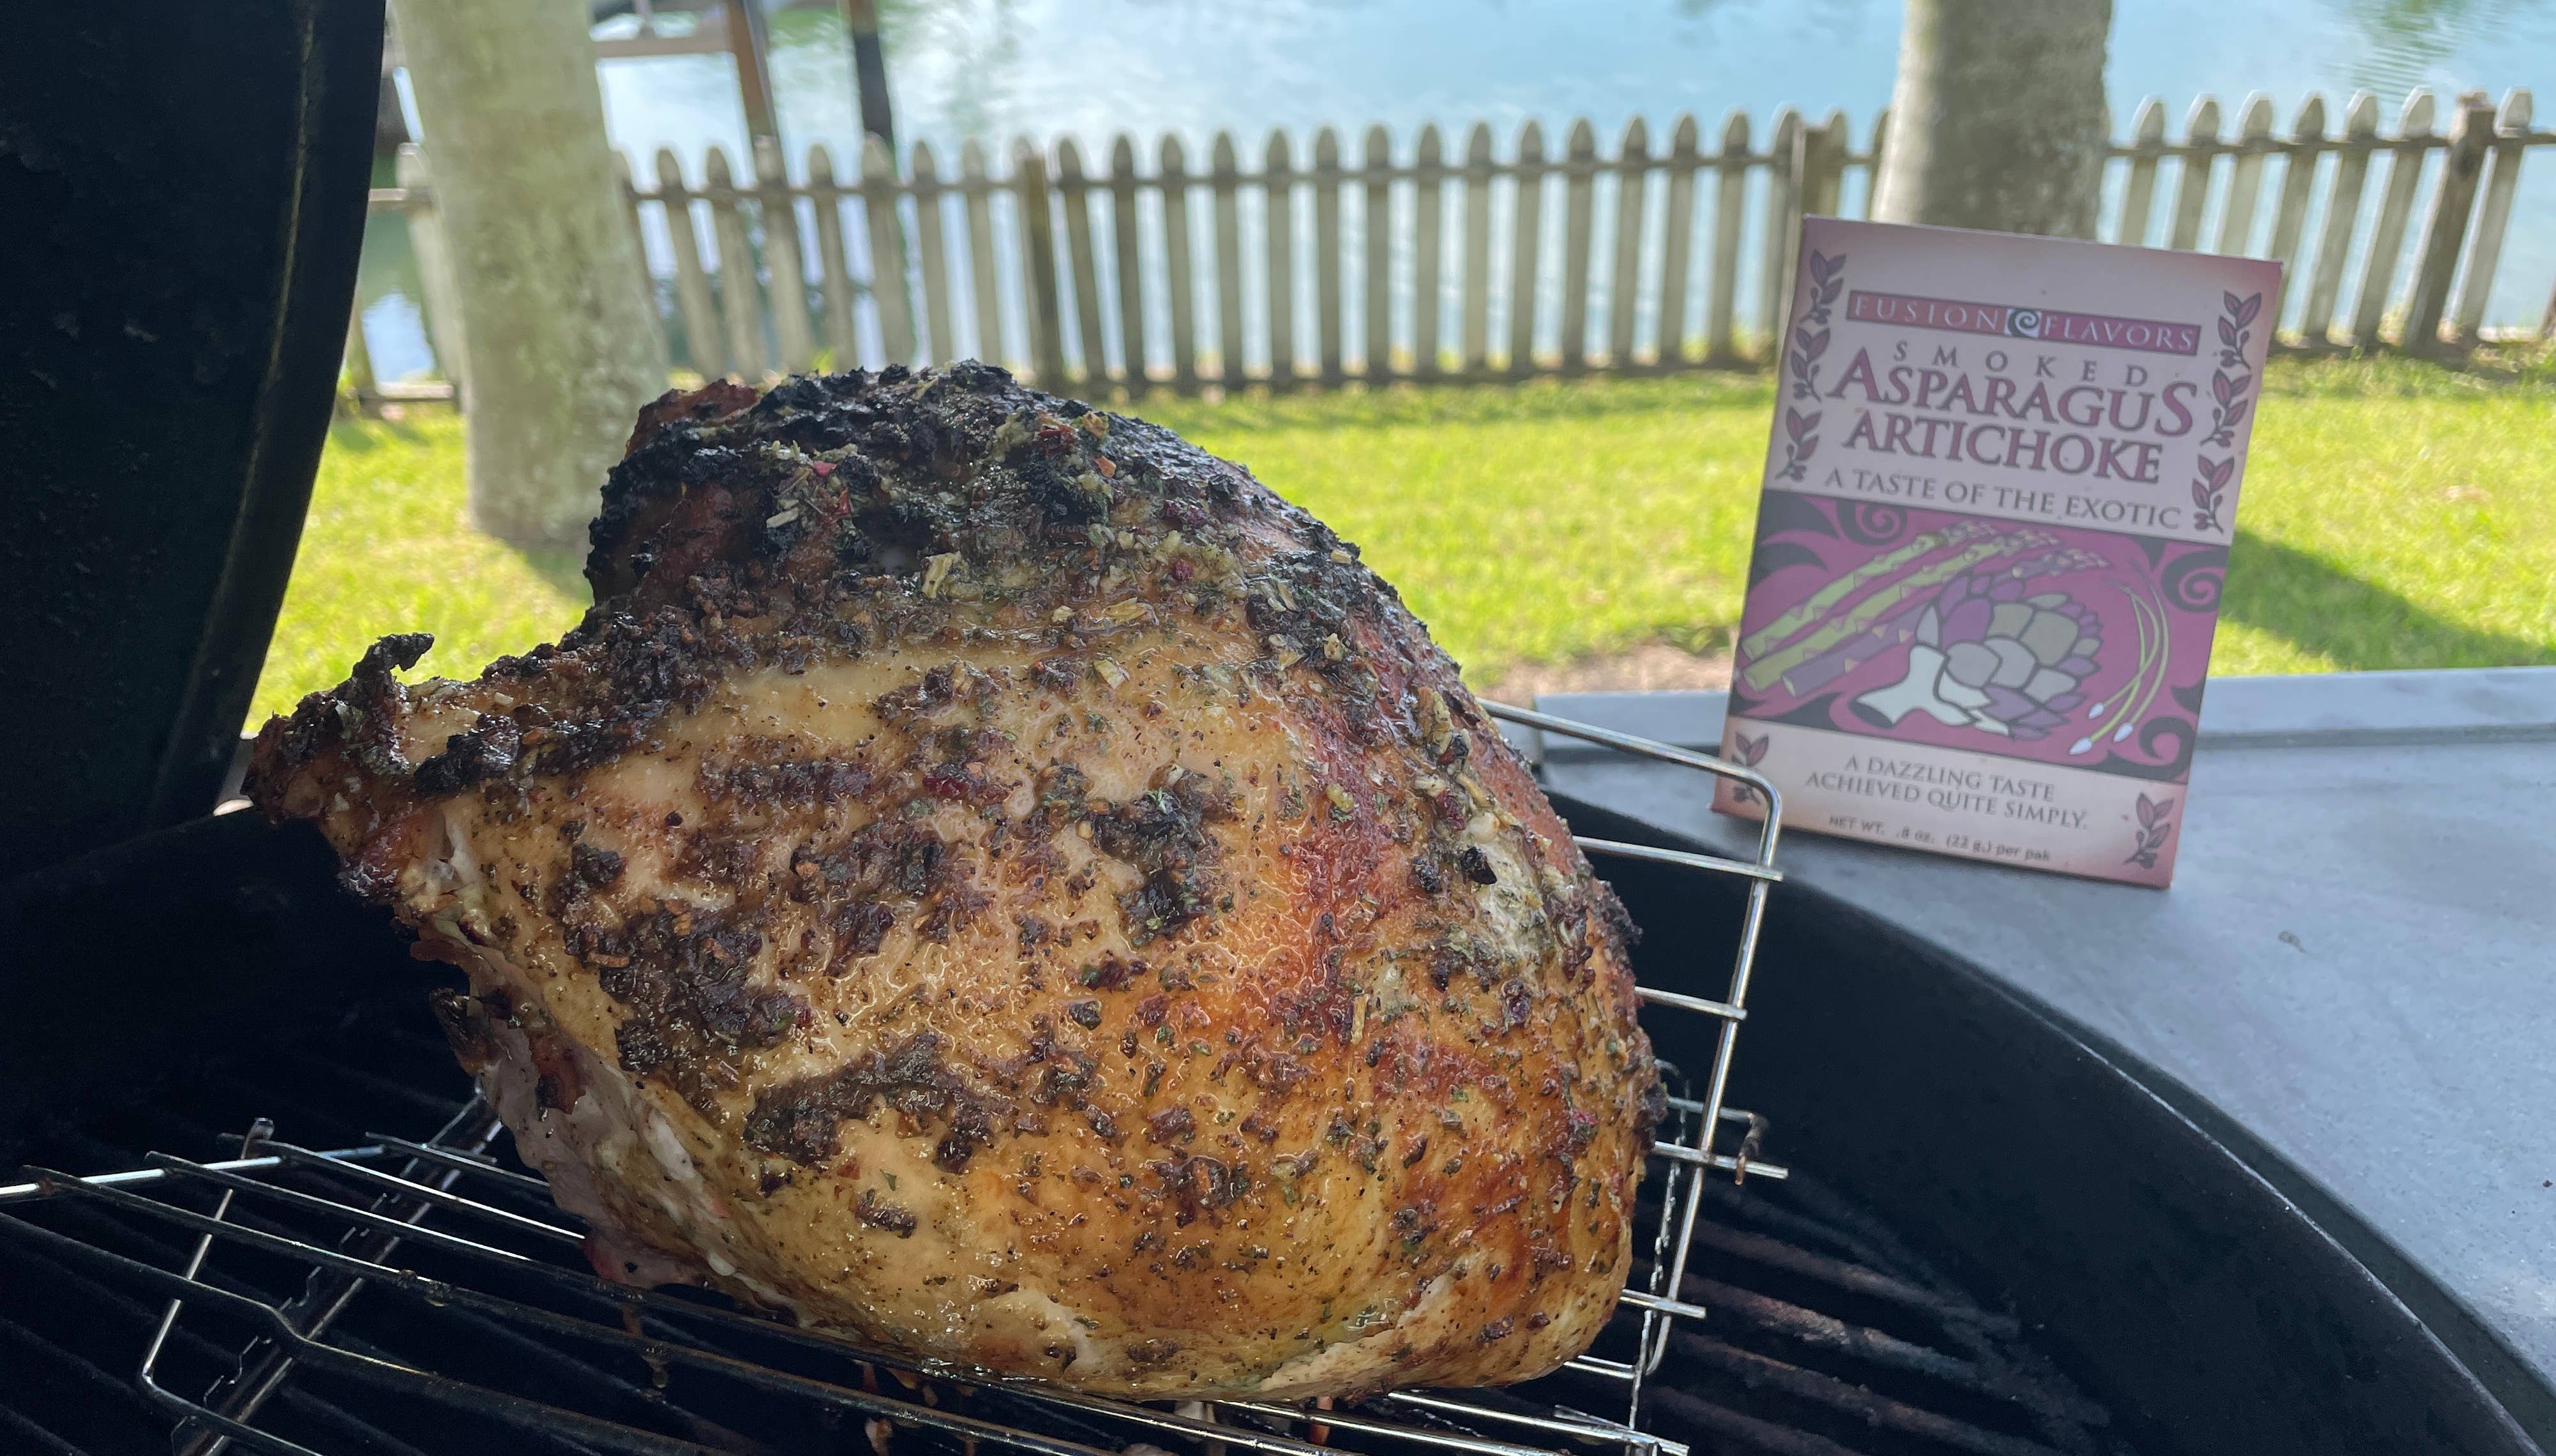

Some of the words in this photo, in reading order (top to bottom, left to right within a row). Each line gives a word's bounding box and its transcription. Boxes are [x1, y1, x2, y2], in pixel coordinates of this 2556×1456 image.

[1853, 292, 2001, 331] FUSION
[2043, 316, 2195, 351] FLAVORS
[1893, 340, 2147, 384] SMOKED
[1827, 347, 2197, 439] ASPARAGUS
[1843, 410, 2163, 483] ARTICHOKE
[1824, 468, 1844, 487] A
[1853, 469, 1936, 499] TASTE
[1944, 481, 1984, 505] OF
[1992, 486, 2053, 514] THE
[2066, 497, 2181, 529] EXOTIC
[1806, 772, 1920, 802] ACHIEVED
[1927, 788, 1997, 816] QUITE
[2004, 800, 2087, 830] SIMPLY.
[1846, 756, 1858, 771] A
[1869, 757, 1980, 790] DAZZLING
[1988, 776, 2054, 802] TASTE
[1830, 816, 1856, 829] NET
[1996, 843, 2021, 860] per
[2024, 848, 2050, 864] pak
